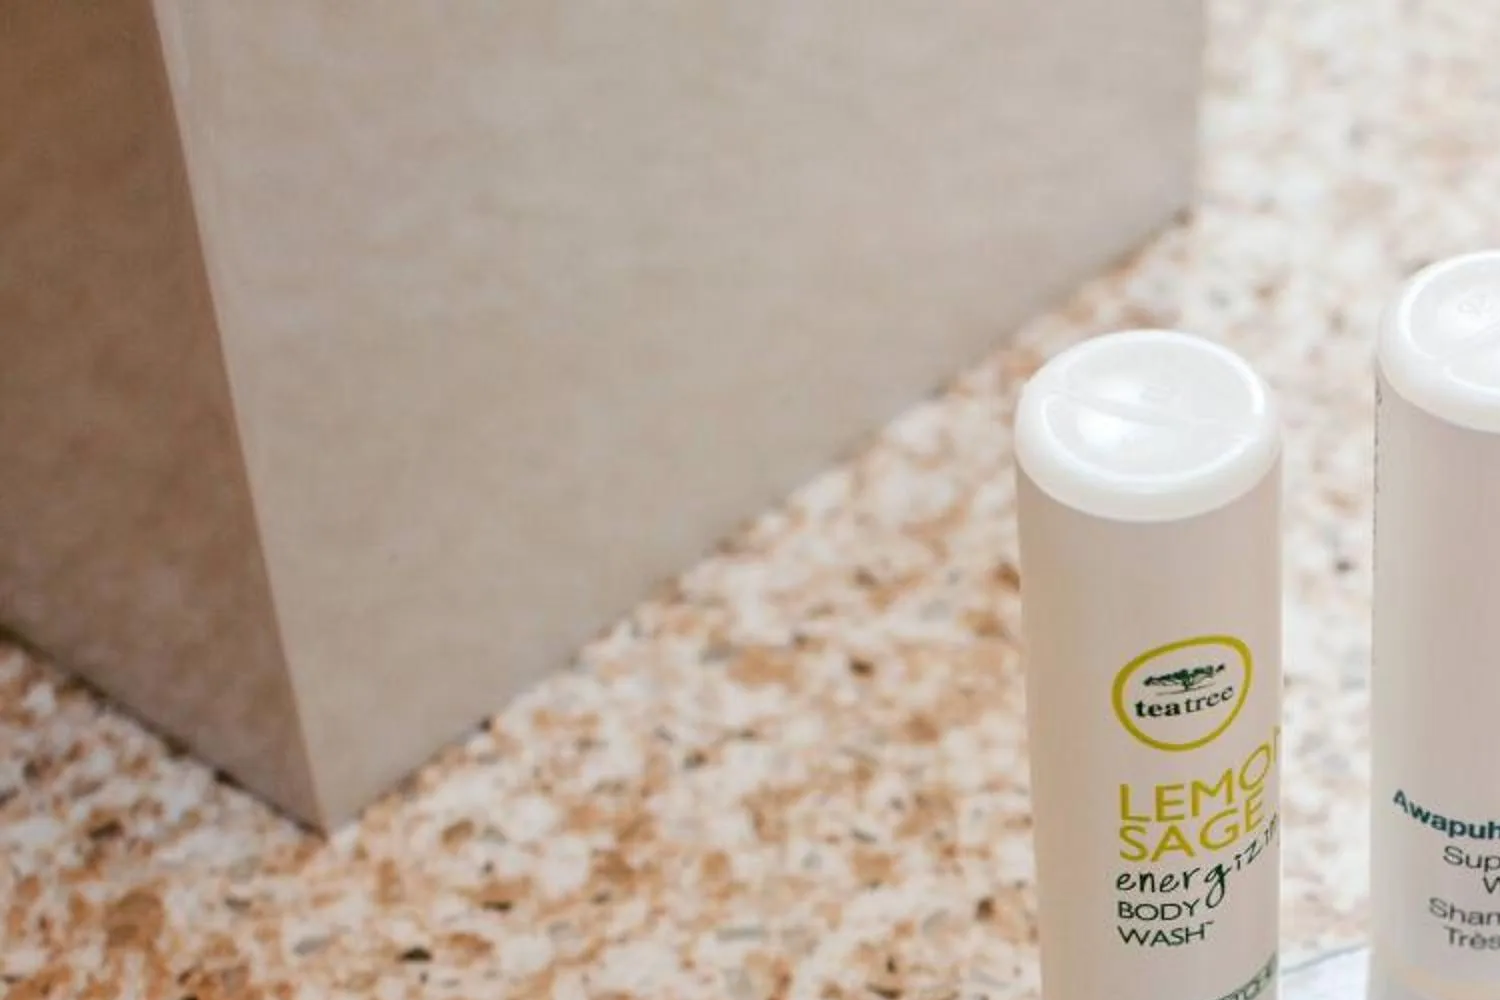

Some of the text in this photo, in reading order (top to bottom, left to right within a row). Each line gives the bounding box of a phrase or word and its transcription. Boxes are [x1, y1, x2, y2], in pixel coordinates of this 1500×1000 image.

[1119, 785, 1265, 863] SAGE
[1118, 898, 1201, 921] BODY
[1117, 922, 1206, 947] WASH
